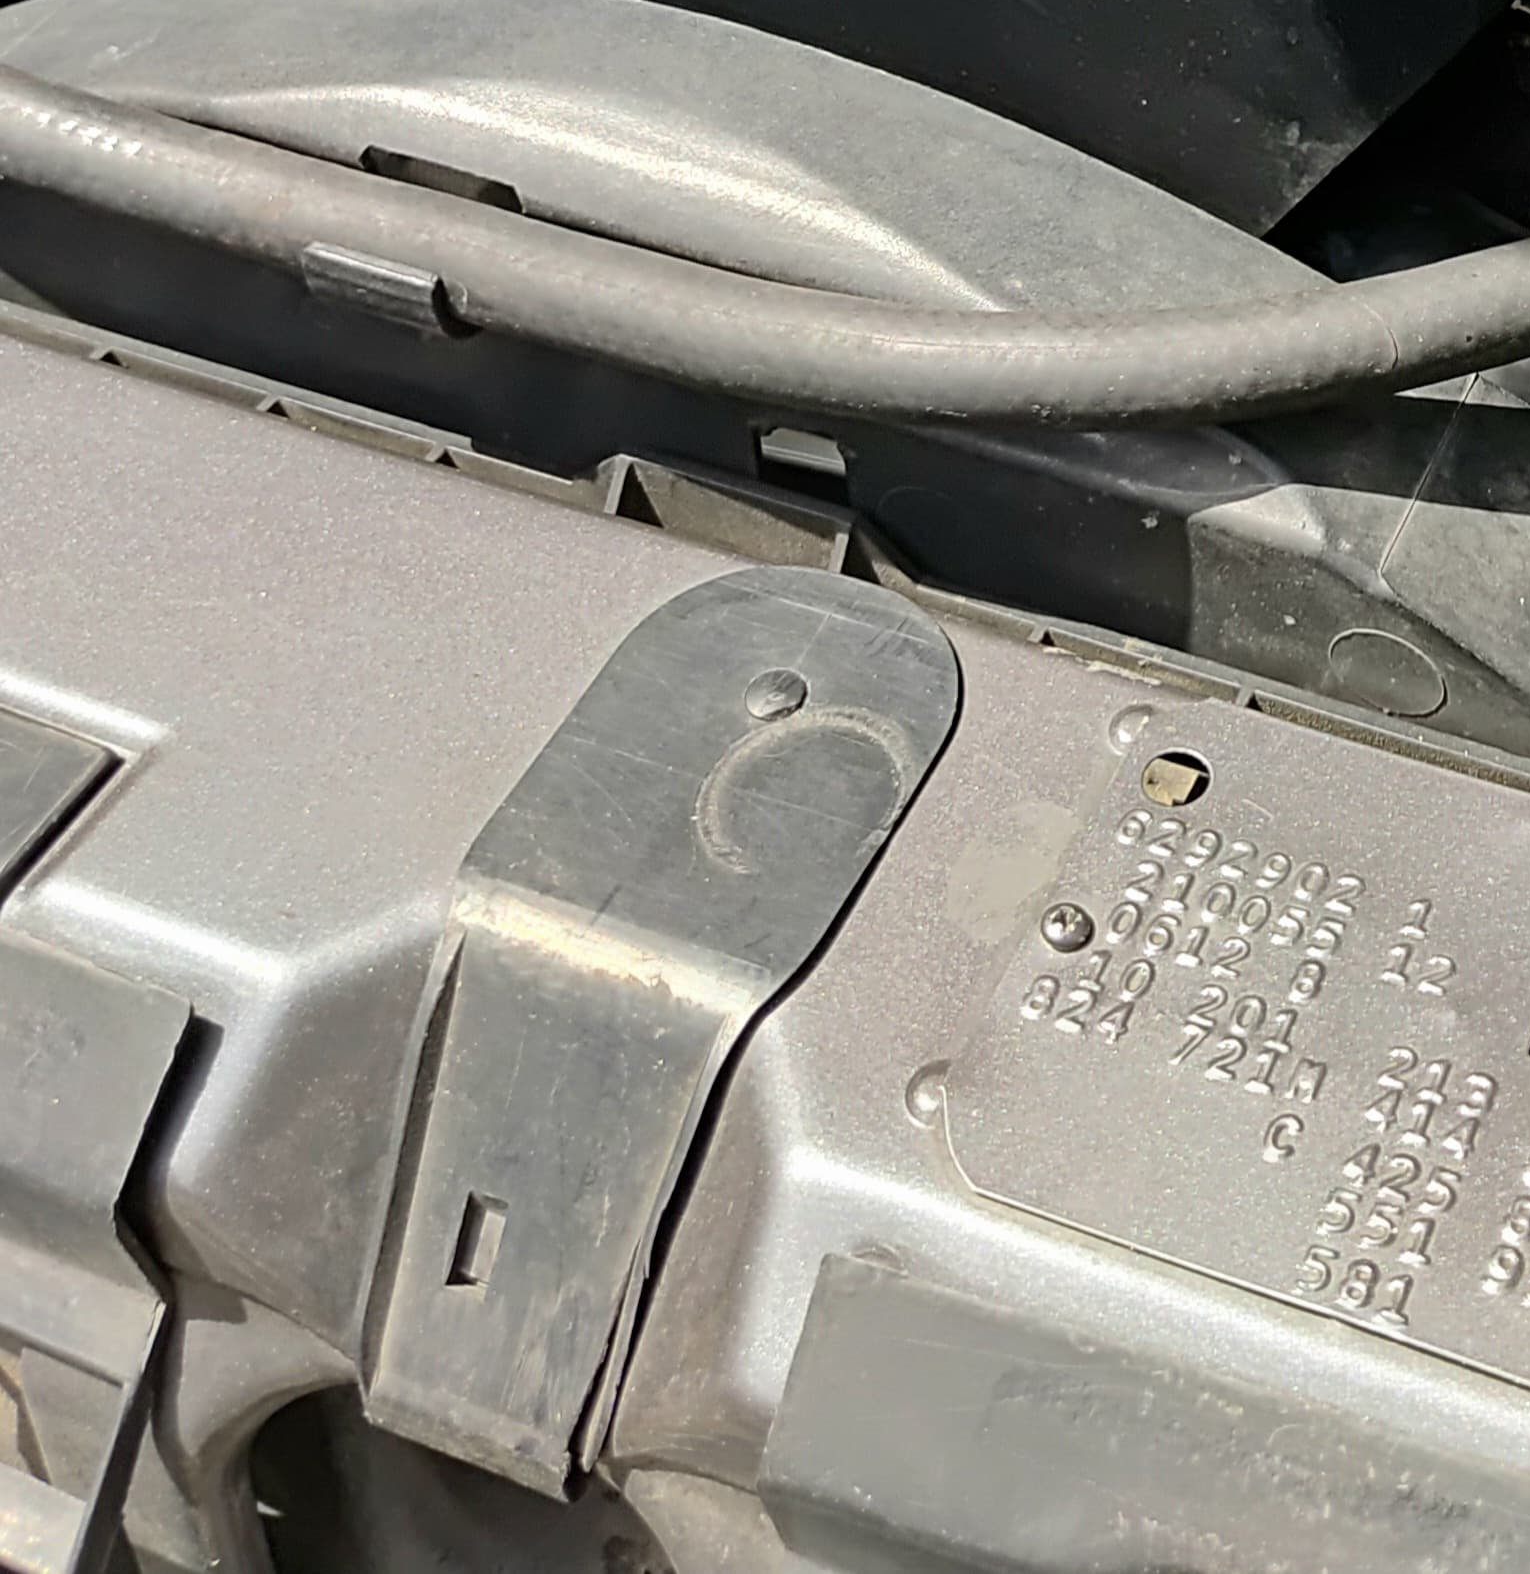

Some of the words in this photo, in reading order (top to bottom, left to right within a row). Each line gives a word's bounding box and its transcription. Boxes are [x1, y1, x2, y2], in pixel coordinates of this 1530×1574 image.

[1117, 809, 1366, 914] 6292902
[1399, 898, 1433, 940] 1
[1124, 860, 1347, 959] 210055
[1380, 942, 1457, 997] 12
[1106, 901, 1251, 978] 0612
[1288, 959, 1327, 1004] 8
[1020, 975, 1136, 1044] 824
[1364, 1088, 1481, 1161] 414
[1078, 950, 1156, 1002] 10
[1186, 983, 1298, 1054] 201
[1377, 1046, 1498, 1116] 213
[1262, 1113, 1305, 1163] C
[1342, 1143, 1463, 1213] 425
[1296, 1244, 1415, 1326] 581
[1315, 1187, 1436, 1267] 551
